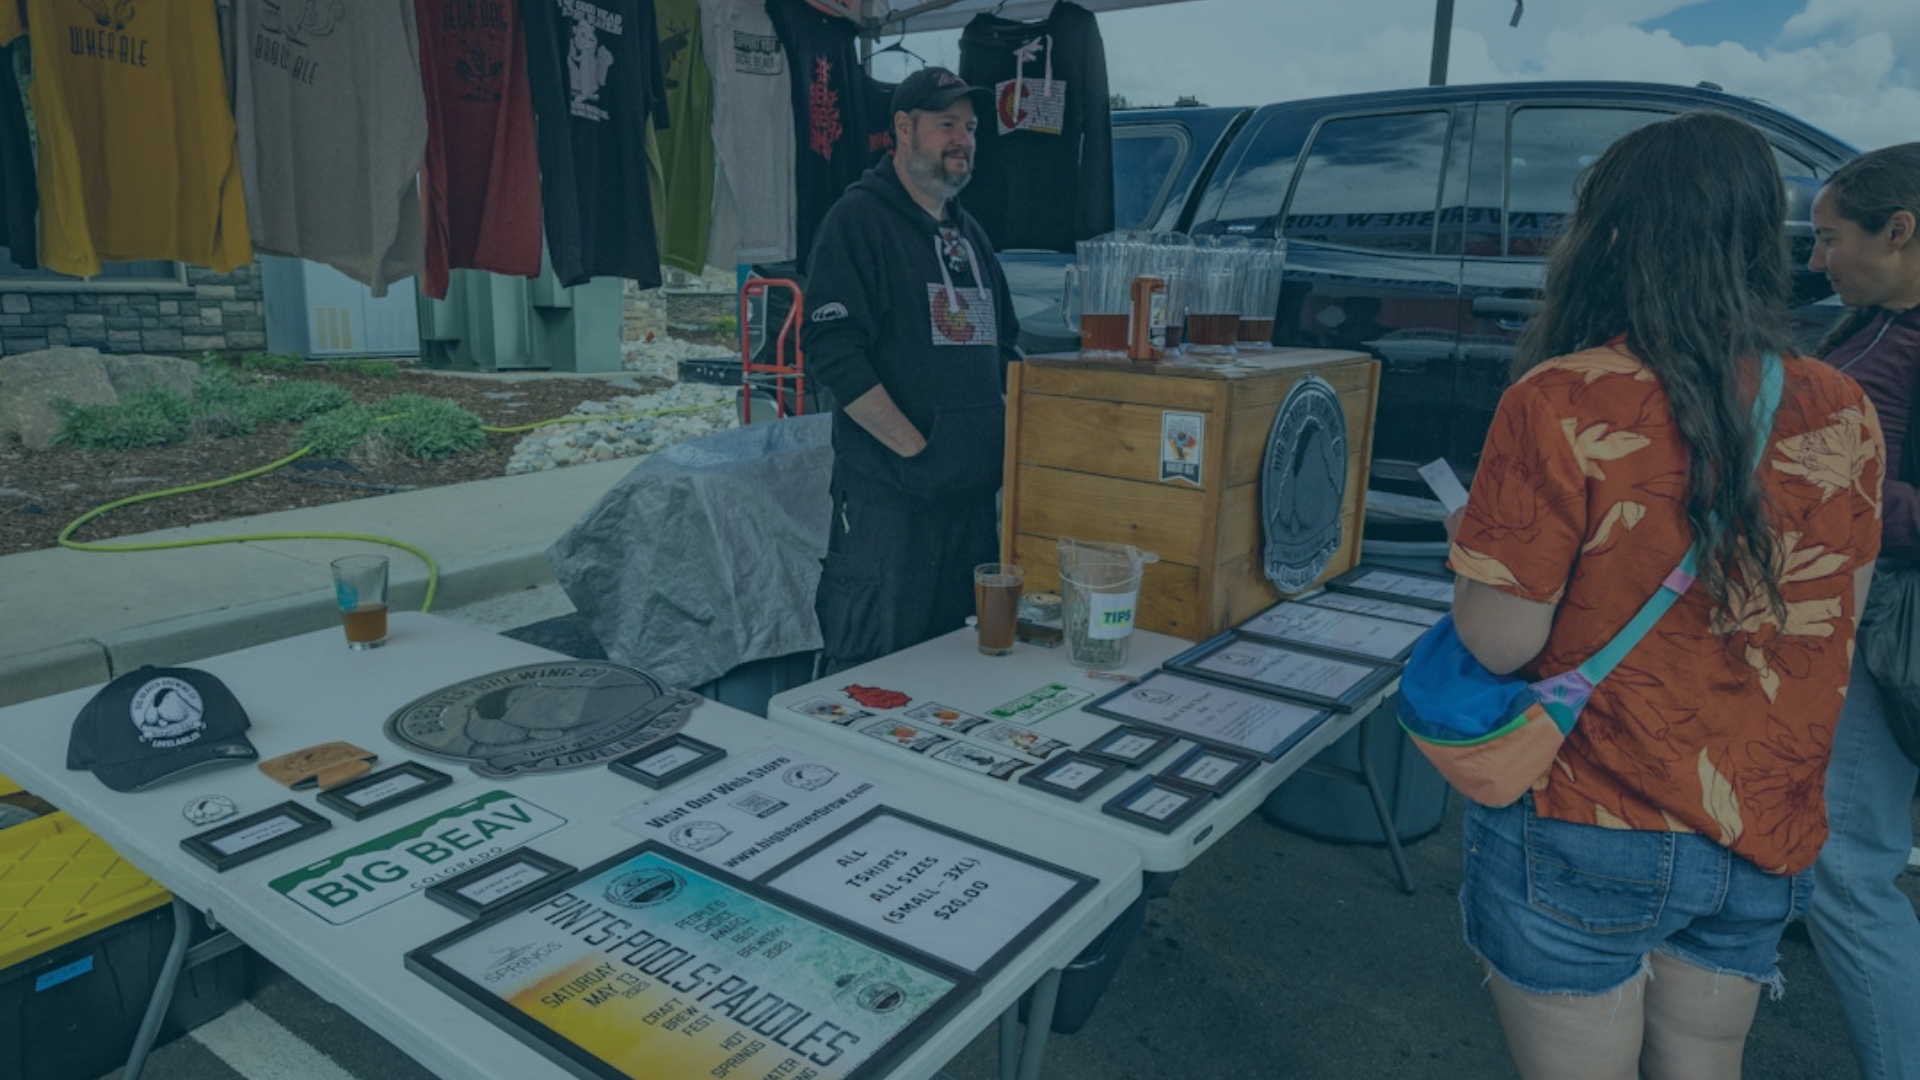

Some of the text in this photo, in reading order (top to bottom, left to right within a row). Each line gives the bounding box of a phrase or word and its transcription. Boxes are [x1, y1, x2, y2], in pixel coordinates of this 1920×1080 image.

[120, 35, 149, 67] ALE
[293, 55, 321, 85] ALE
[1104, 609, 1131, 623] TIPS
[475, 667, 574, 690] BREWING
[645, 756, 790, 829] Visit Our Web Store
[308, 803, 534, 908] BIG BEAV
[411, 846, 503, 889] COLORADO
[836, 850, 868, 868] ALL
[845, 849, 908, 887] TSHIRTS
[869, 856, 939, 903] ALL SIZES
[882, 888, 940, 924] (SMALL
[943, 857, 981, 881] 3XL)
[934, 880, 989, 921] $20.00
[710, 916, 750, 941] AWARD
[730, 926, 760, 943] BEST
[484, 941, 563, 984] SPRINGS
[541, 961, 618, 1010] SATURDAY
[583, 972, 640, 1008] MAY 13
[642, 997, 684, 1026] CRAFT
[662, 1005, 700, 1031] BREW
[682, 1014, 716, 1037] FEST
[720, 1031, 748, 1051] HOT
[711, 1040, 766, 1079] SPRINGS
